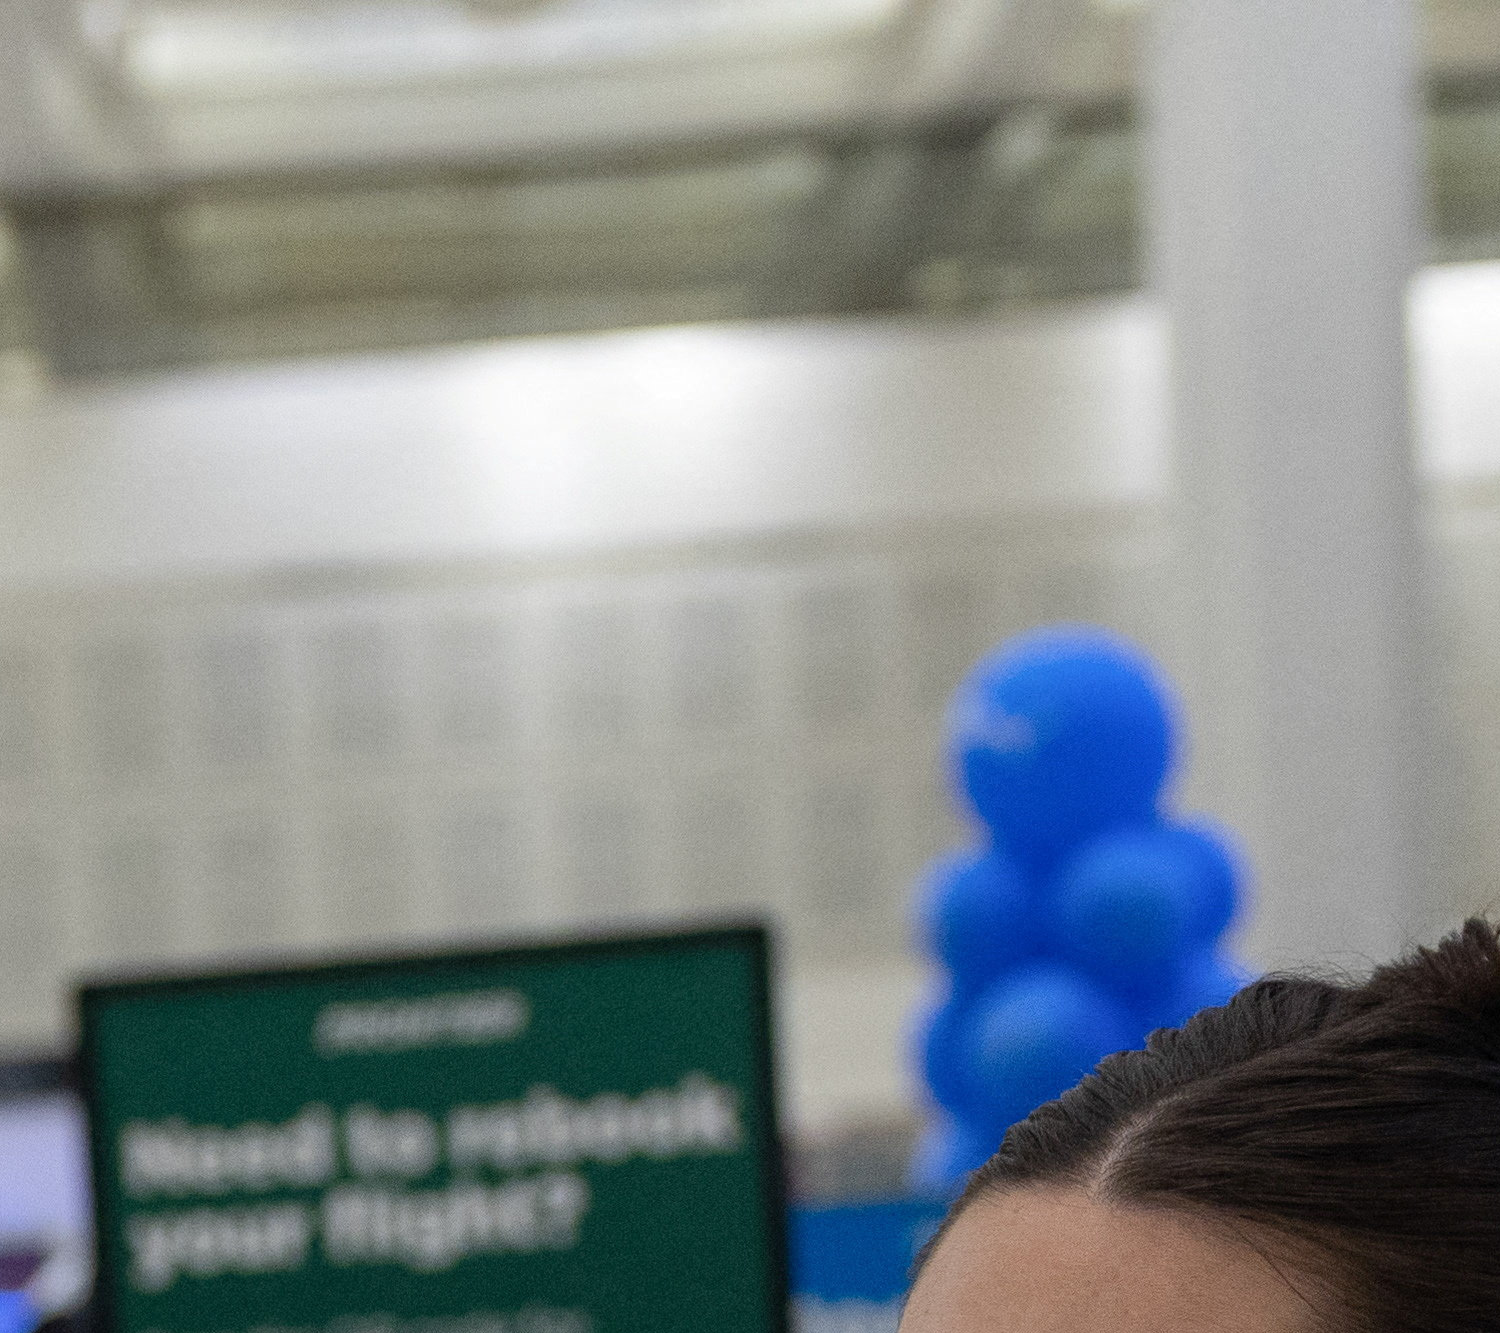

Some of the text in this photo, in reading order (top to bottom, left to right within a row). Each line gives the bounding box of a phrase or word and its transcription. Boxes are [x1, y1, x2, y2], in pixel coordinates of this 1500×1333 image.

[129, 1078, 739, 1195] Need to rebook
[132, 1179, 582, 1286] your flight?
